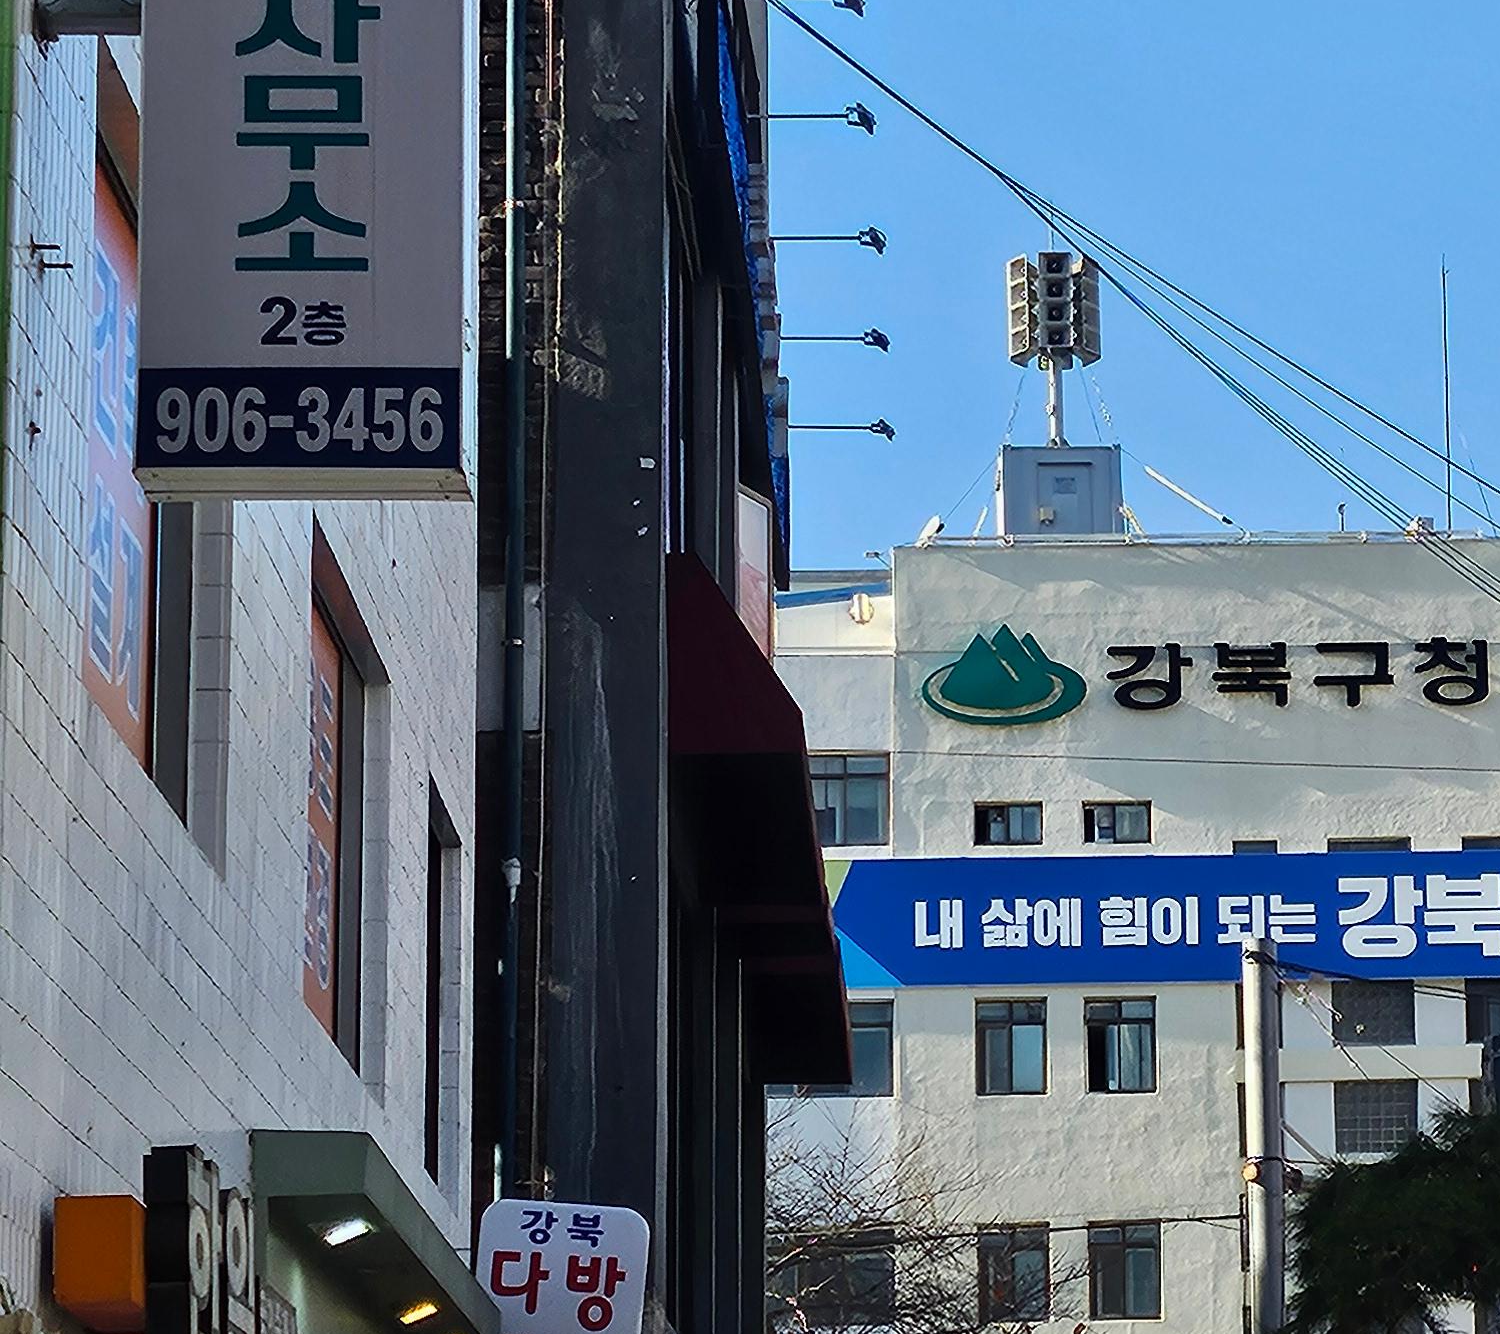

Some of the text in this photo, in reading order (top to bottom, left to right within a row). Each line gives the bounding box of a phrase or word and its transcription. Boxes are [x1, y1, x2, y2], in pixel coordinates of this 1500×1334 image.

[259, 296, 347, 347] 2층
[156, 386, 444, 455] 906-3456
[1105, 636, 1491, 710] 강북구청
[914, 898, 964, 949] 내
[981, 896, 1082, 948] 삶에
[1099, 894, 1198, 947] 힘이
[1217, 892, 1317, 946] 되는
[520, 1210, 605, 1249] 강북
[489, 1250, 627, 1332] 다방
